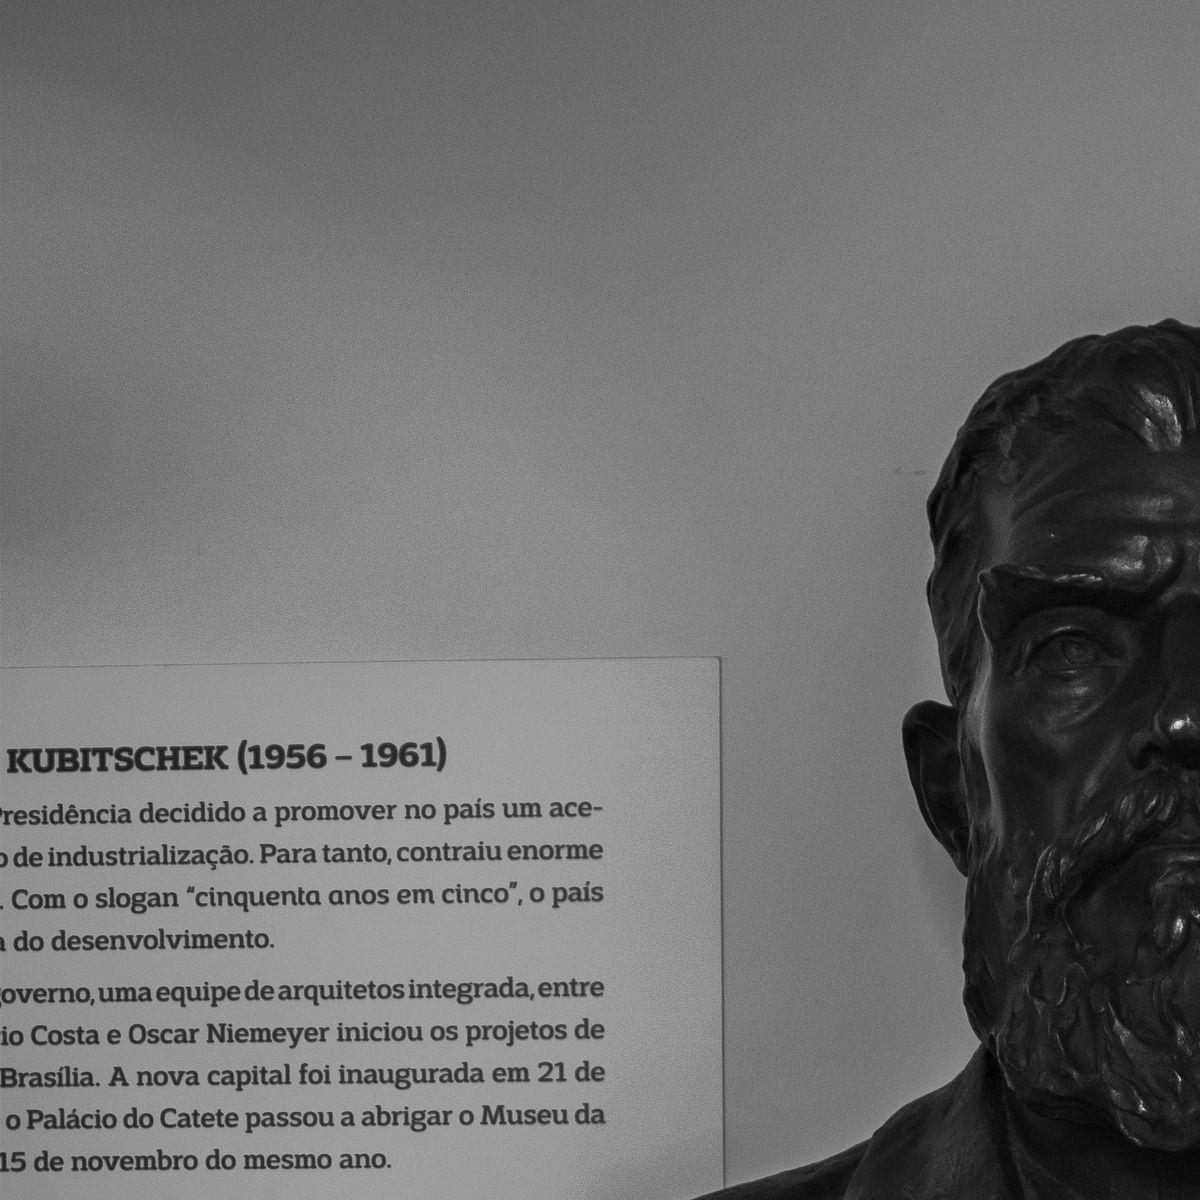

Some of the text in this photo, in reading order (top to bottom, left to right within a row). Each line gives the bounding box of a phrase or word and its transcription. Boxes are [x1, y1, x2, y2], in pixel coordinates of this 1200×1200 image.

[6, 744, 230, 775] KUBITSCHEK
[237, 738, 328, 776] (1956
[360, 735, 447, 773] 1961)
[0, 797, 603, 828] residência decidido a promover no país um ace-
[12, 845, 44, 868] de
[47, 843, 255, 871] industrialização.
[259, 843, 318, 865] Para
[321, 843, 393, 866] tanto,
[396, 840, 503, 863] contraiu
[506, 843, 604, 862] enorme
[11, 888, 67, 911] Com
[72, 892, 89, 910] o
[95, 886, 180, 915] slogan
[327, 888, 390, 906] anos
[396, 888, 436, 905] em
[529, 886, 546, 904] o
[551, 880, 605, 910] país
[12, 929, 45, 953] do
[50, 927, 275, 952] desenvolvimento.
[0, 975, 605, 1009] overno, uma equipe de arquitetos integrada, entre
[0, 1017, 606, 1050] io Costa e Oscar Niemeyer iniciou os projetos de
[0, 1059, 606, 1092] Brasília. A nova capital foi inaugurada em 21 de
[5, 1102, 607, 1135] o Palácio do Catete passou a abrigar o Museu da
[0, 1148, 392, 1173] 15 de novembro do mesmo ano.
